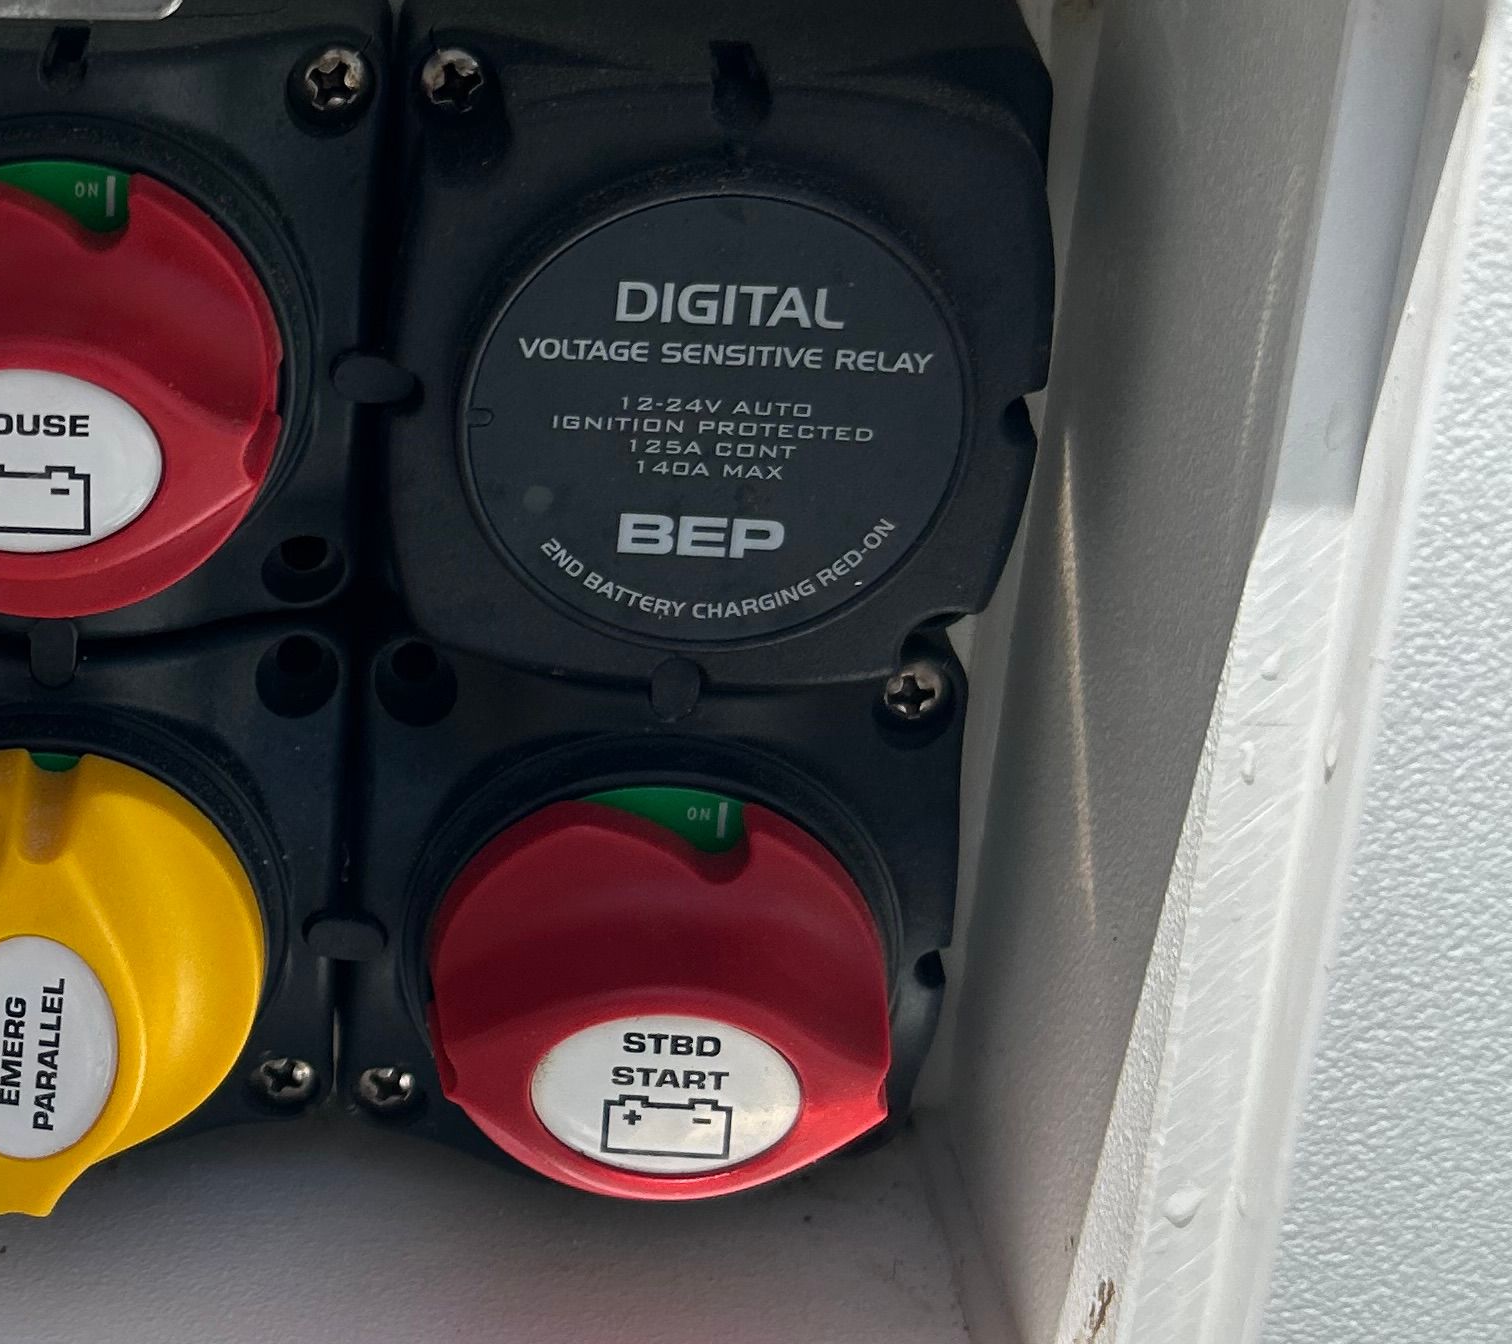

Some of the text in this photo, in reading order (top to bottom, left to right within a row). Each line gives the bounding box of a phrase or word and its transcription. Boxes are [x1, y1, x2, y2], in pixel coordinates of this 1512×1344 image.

[75, 181, 98, 198] ON
[615, 281, 844, 329] DIGITAL
[518, 337, 933, 375] VOLTAGE SENSITIVE RELAY
[621, 396, 812, 417] 12-24V AUTO
[552, 415, 873, 442] IGNITION PROTECTED
[629, 439, 796, 459] 125A CONT
[636, 460, 783, 480] 140A MAX
[617, 513, 785, 558] BEP
[541, 519, 895, 619] 2ND BATTERY CHARGING RED-ON
[687, 807, 710, 821] ON
[0, 997, 27, 1106] EMERG
[32, 978, 65, 1130] PARALLEL
[623, 1032, 721, 1057] STBD
[612, 1066, 729, 1090] START
